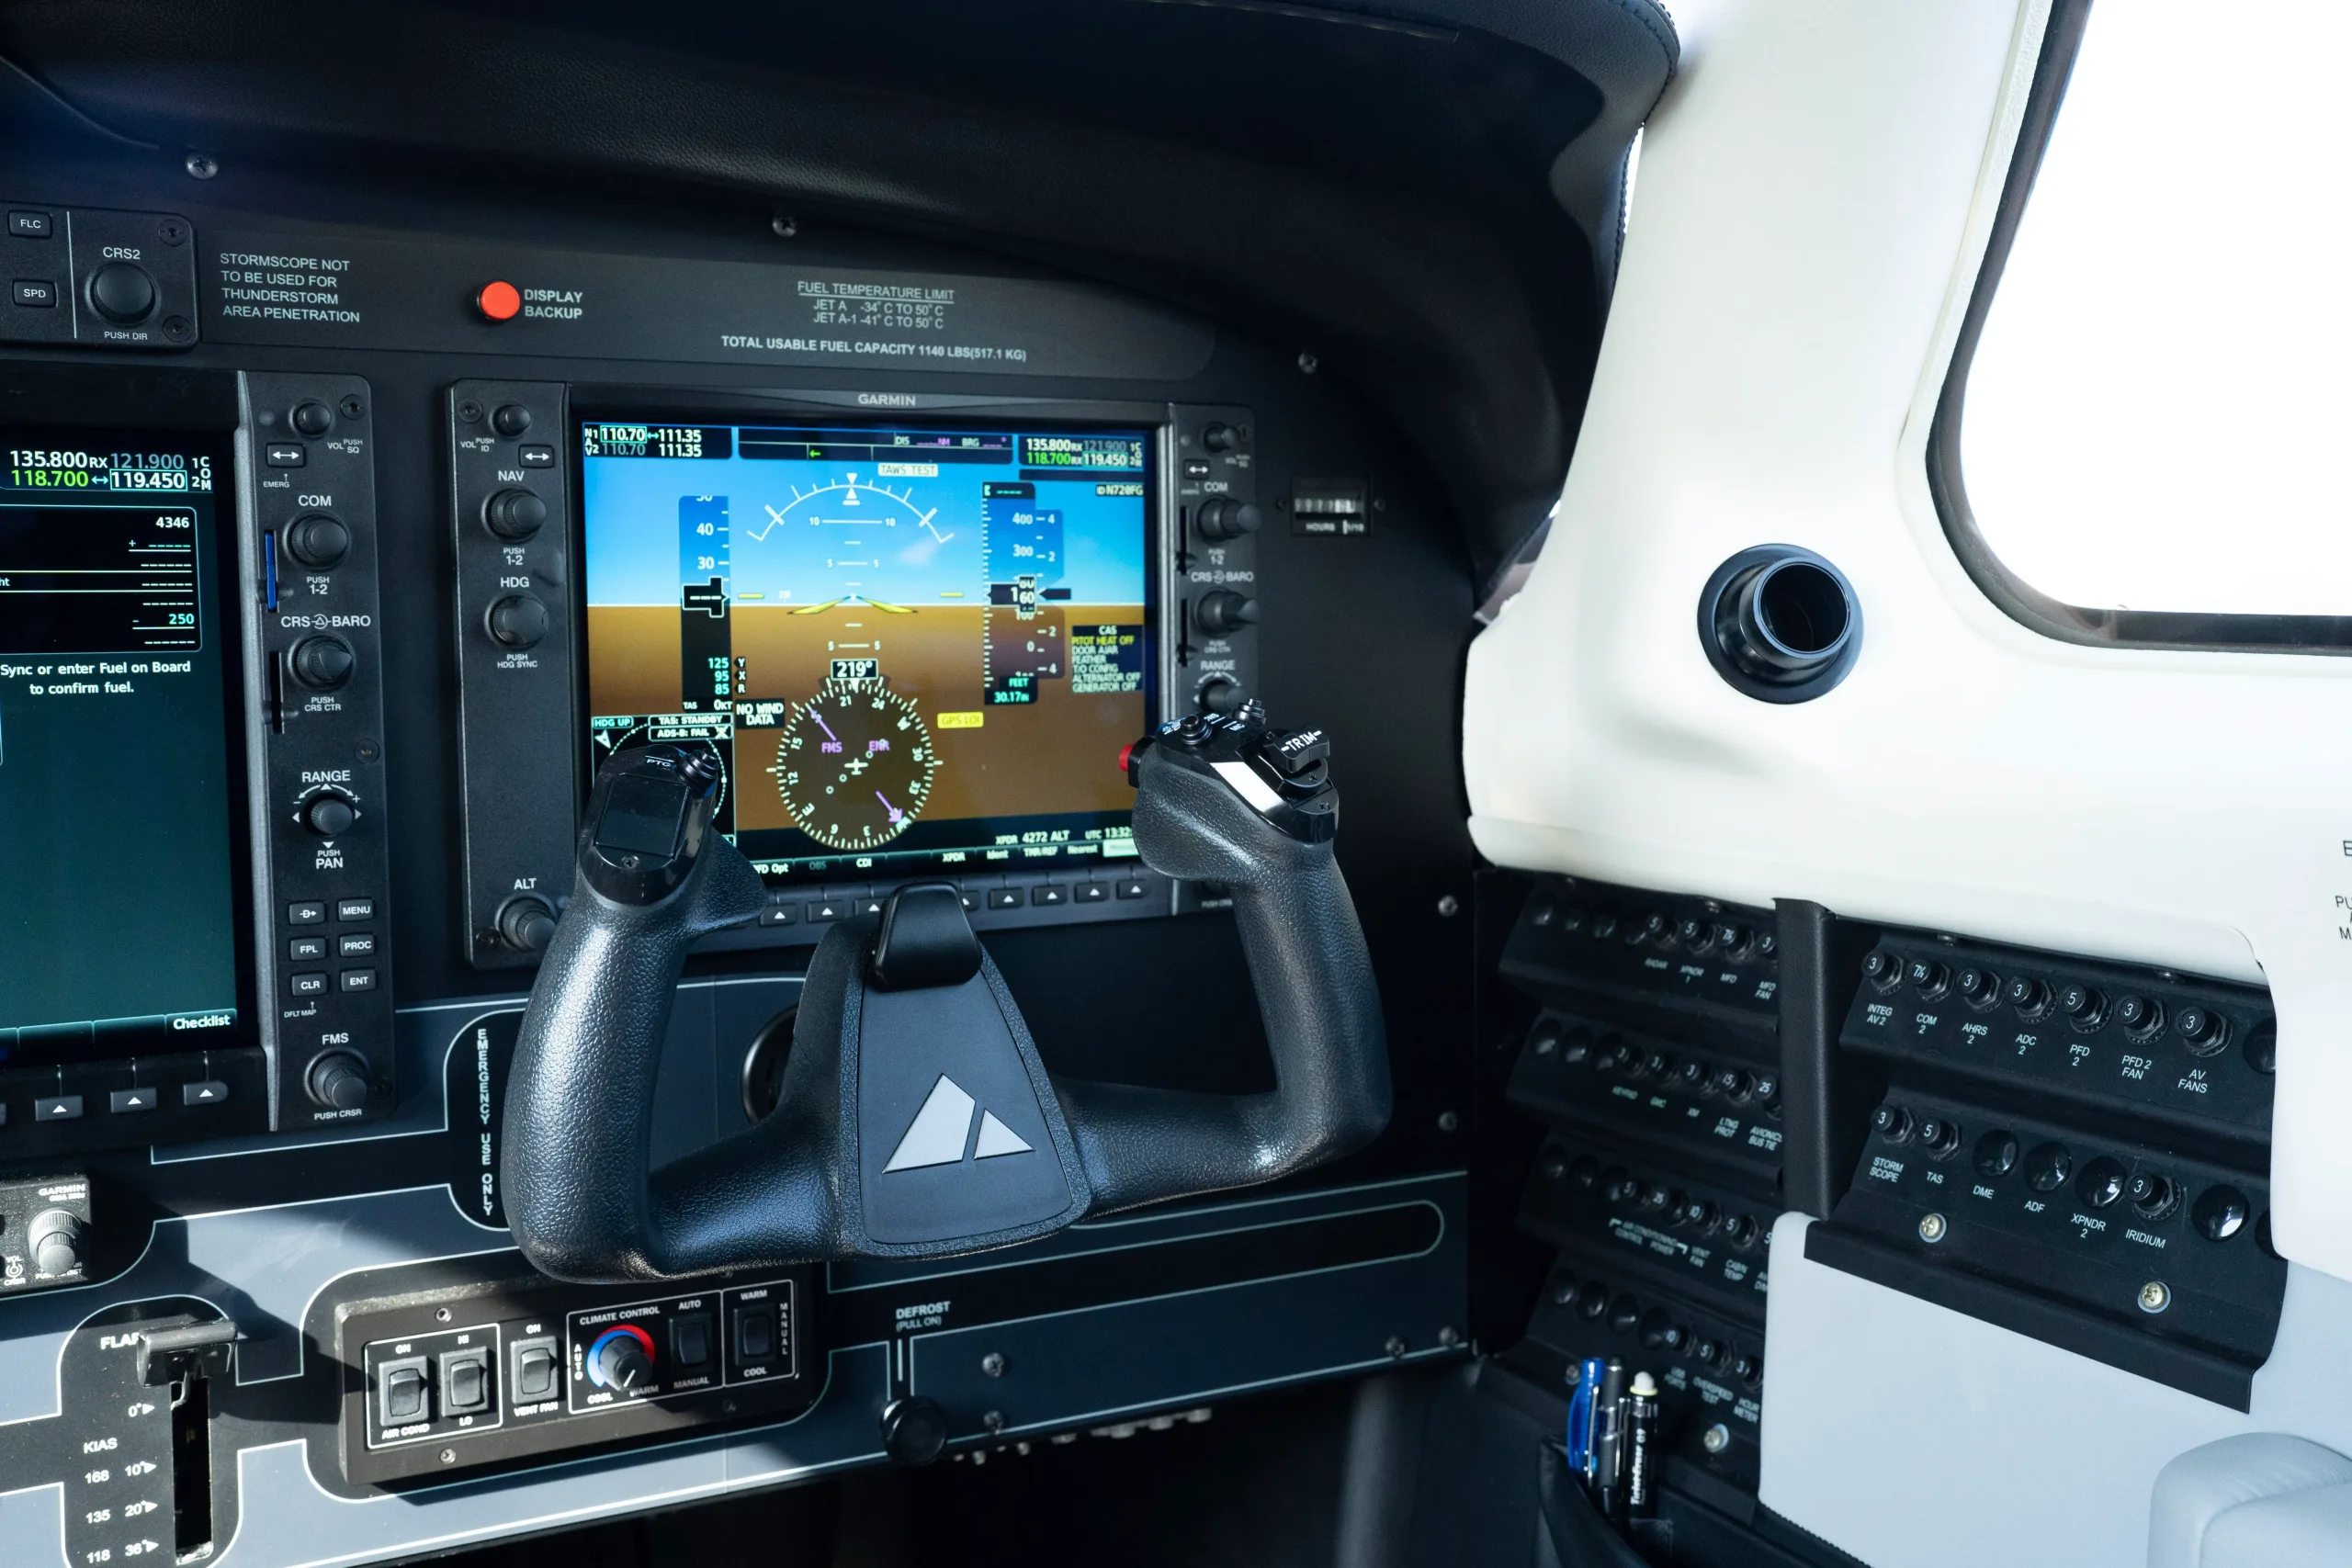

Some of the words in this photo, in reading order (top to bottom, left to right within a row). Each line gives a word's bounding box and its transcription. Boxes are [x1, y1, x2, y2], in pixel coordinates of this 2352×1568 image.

[20, 218, 41, 229] FLC
[103, 246, 141, 260] CRS2
[220, 253, 318, 270] STORMSCOPE
[322, 259, 350, 271] NOT
[221, 271, 241, 283] TO
[244, 272, 264, 284] BE
[267, 274, 305, 286] USED
[309, 276, 337, 288] FOR
[23, 288, 47, 299] SPD
[222, 288, 339, 305] THUNDERSTORM
[524, 288, 583, 303] DISPLAY
[797, 281, 829, 294] FUEL
[832, 283, 922, 299] TEMPERATURE
[924, 289, 956, 301] LIMIT
[525, 305, 583, 320] BACKUP
[813, 299, 835, 310] JET
[896, 303, 913, 315] TO
[223, 305, 262, 318] AREA
[265, 307, 360, 323] PENETRATION
[813, 312, 835, 323] JET
[838, 313, 856, 324] A-1
[896, 316, 913, 328] TO
[104, 331, 130, 341] PUSH
[132, 332, 148, 342] DIR
[721, 334, 763, 349] TOTAL
[766, 337, 818, 351] USABLE
[820, 340, 852, 353] FUEL
[854, 341, 916, 355] CAPACITY
[919, 344, 944, 356] 1140
[1005, 349, 1027, 362] KG)
[857, 393, 916, 407] GARMIN
[602, 427, 646, 441] 110.70
[658, 429, 702, 443] 111.35
[659, 443, 703, 457] 111.35
[10, 450, 87, 468] 135.800
[89, 457, 107, 468] RX
[110, 453, 185, 469] 121.900
[497, 470, 525, 482] NAV
[881, 465, 908, 475] TAWS
[911, 466, 935, 475] TEST
[12, 469, 89, 487] 118.700
[111, 472, 186, 489] 119.450
[298, 495, 332, 508] COM
[155, 516, 190, 528] 4346
[696, 523, 714, 536] 40
[505, 556, 524, 566] 1-2
[697, 557, 715, 570] 30
[306, 576, 330, 584] PUSH
[500, 577, 530, 588] HDG
[309, 584, 328, 595] 1-2
[168, 614, 195, 625] 250
[280, 615, 311, 628] CRS
[332, 615, 371, 627] BARO
[1099, 625, 1117, 636] CAS
[506, 653, 528, 661] PUSH
[707, 658, 729, 669] 125
[0, 663, 33, 678] Sync
[38, 665, 52, 675] or
[58, 664, 96, 674] enter
[99, 661, 128, 673] Fuel
[131, 663, 149, 673] on
[152, 660, 191, 672] Board
[714, 671, 729, 682] 95
[29, 683, 44, 695] to
[48, 682, 99, 694] confirm
[104, 681, 134, 694] fuel.
[714, 683, 729, 694] 85
[311, 696, 334, 705] PUSH
[304, 704, 322, 712] CRS
[324, 704, 341, 712] CTR
[737, 704, 753, 715] NO
[756, 702, 784, 714] WIND
[594, 718, 615, 728] HDG
[617, 718, 630, 727] UP
[681, 716, 723, 725] STANDBY
[746, 714, 775, 726] DATA
[942, 716, 963, 725] GPS
[821, 742, 842, 753] FMS
[301, 770, 351, 783] RANGE
[1023, 831, 1048, 843] 4272
[1050, 830, 1070, 842] ALT
[317, 849, 341, 857] PUSH
[315, 857, 344, 869] PAN
[856, 858, 873, 868] CDI
[514, 877, 537, 890] ALT
[342, 905, 371, 916] MENU
[300, 944, 318, 954] FPL
[344, 941, 372, 951] PROC
[300, 979, 321, 990] CLR
[349, 976, 368, 987] ENT
[1867, 1003, 1893, 1016] INTEG
[173, 1014, 231, 1031] Checklist
[1867, 1014, 1879, 1024] AV
[1917, 1013, 1938, 1025] COM
[1962, 1022, 1988, 1036] AHRS
[322, 1032, 349, 1045] FMS
[2016, 1033, 2037, 1045] ADC
[2069, 1043, 2090, 1056] PFD
[2121, 1055, 2143, 1068] PFD
[477, 1028, 491, 1125] EMERGENCY
[2121, 1066, 2144, 1080] FAN
[2188, 1068, 2207, 1080] AV
[2177, 1078, 2209, 1094] FANS
[314, 1111, 336, 1121] PUSH
[338, 1109, 362, 1118] CRSR
[481, 1133, 492, 1166] USE
[1872, 1156, 1905, 1173] STORM
[1870, 1166, 1900, 1183] SCOPE
[1926, 1171, 1944, 1185] TAS
[39, 1183, 85, 1196] GARMIN
[481, 1173, 493, 1217] ONLY
[1973, 1184, 1995, 1200] DME
[2024, 1200, 2046, 1213] ADF
[2071, 1213, 2107, 1232] XPNDR
[2125, 1228, 2166, 1249] IRIDIUM
[741, 1290, 768, 1302] WARM
[678, 1299, 702, 1311] AUTO
[895, 1300, 952, 1320] DEFROST
[580, 1311, 617, 1325] CLIMATE
[619, 1305, 661, 1320] CONTROL
[526, 1324, 541, 1335] ON
[779, 1303, 788, 1355] MANUAL
[99, 1332, 141, 1350] FLAP
[458, 1335, 469, 1345] HI
[395, 1344, 412, 1354] ON
[574, 1344, 583, 1382] AUTO
[743, 1367, 768, 1378] COOL
[673, 1376, 710, 1389] MANUAL
[587, 1392, 613, 1404] COOL
[514, 1404, 538, 1417] VENT
[539, 1402, 559, 1413] FAN
[459, 1416, 473, 1427] LO
[382, 1427, 400, 1439] AIR
[401, 1424, 431, 1436] COND
[84, 1438, 119, 1453] KIAS
[85, 1470, 110, 1483] 168
[85, 1510, 111, 1524] 135
[86, 1549, 111, 1562] 118
